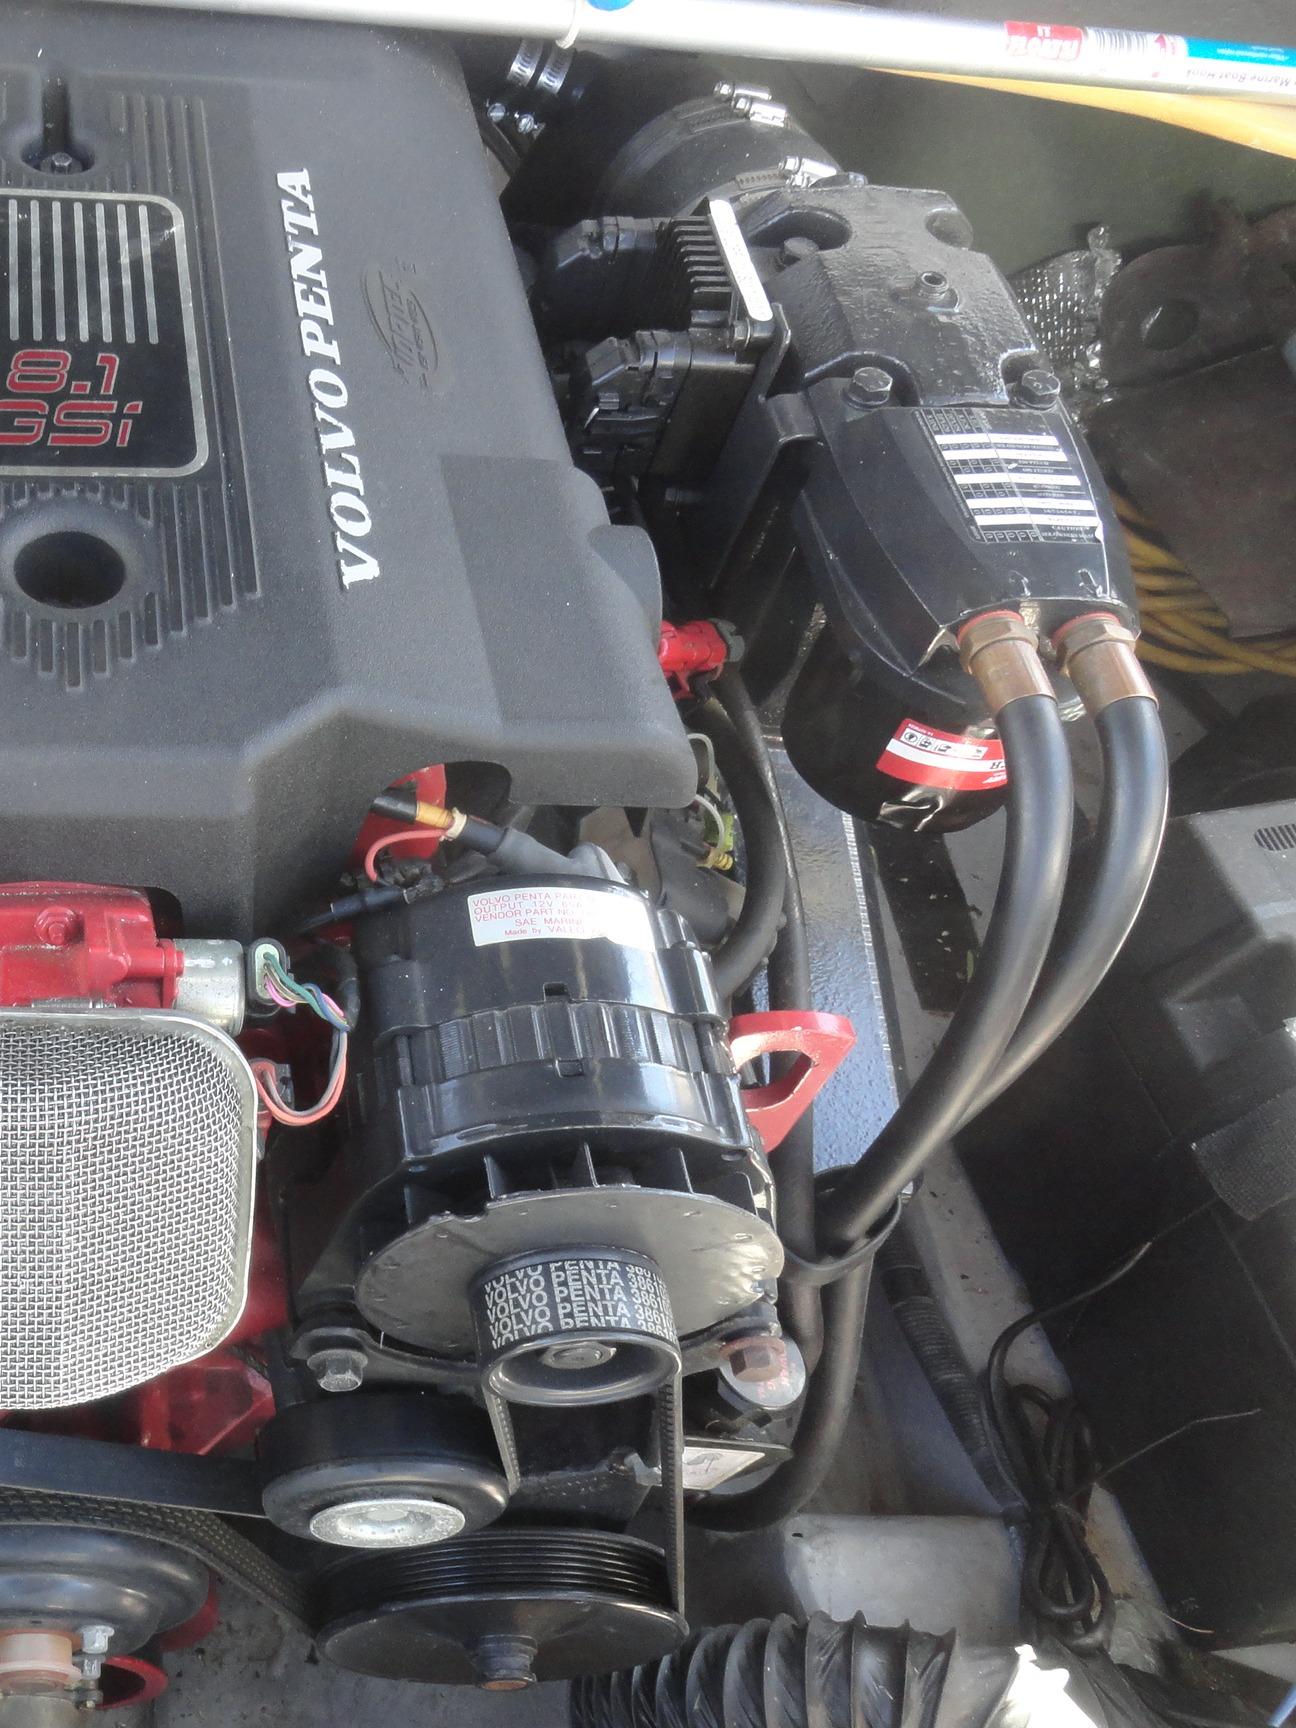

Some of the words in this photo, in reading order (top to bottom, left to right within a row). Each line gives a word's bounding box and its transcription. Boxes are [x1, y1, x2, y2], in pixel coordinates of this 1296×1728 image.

[276, 167, 341, 365] PENTA
[6, 349, 120, 395] 8.1
[308, 368, 381, 591] VOLVO
[473, 895, 511, 907] VOLVO
[514, 892, 551, 901] PENTA
[473, 901, 524, 915] OUTPUT
[475, 909, 522, 923] VENDOR
[525, 908, 555, 918] PART
[504, 927, 528, 937] Made
[532, 927, 542, 936] by
[514, 917, 538, 927] SAE
[485, 1275, 545, 1309] VOLVO
[551, 1269, 624, 1287] PENTA
[487, 1290, 548, 1324] VOLVO
[554, 1285, 628, 1303] PENTA
[489, 1306, 551, 1340] VOLVO
[557, 1300, 631, 1319] PENTA
